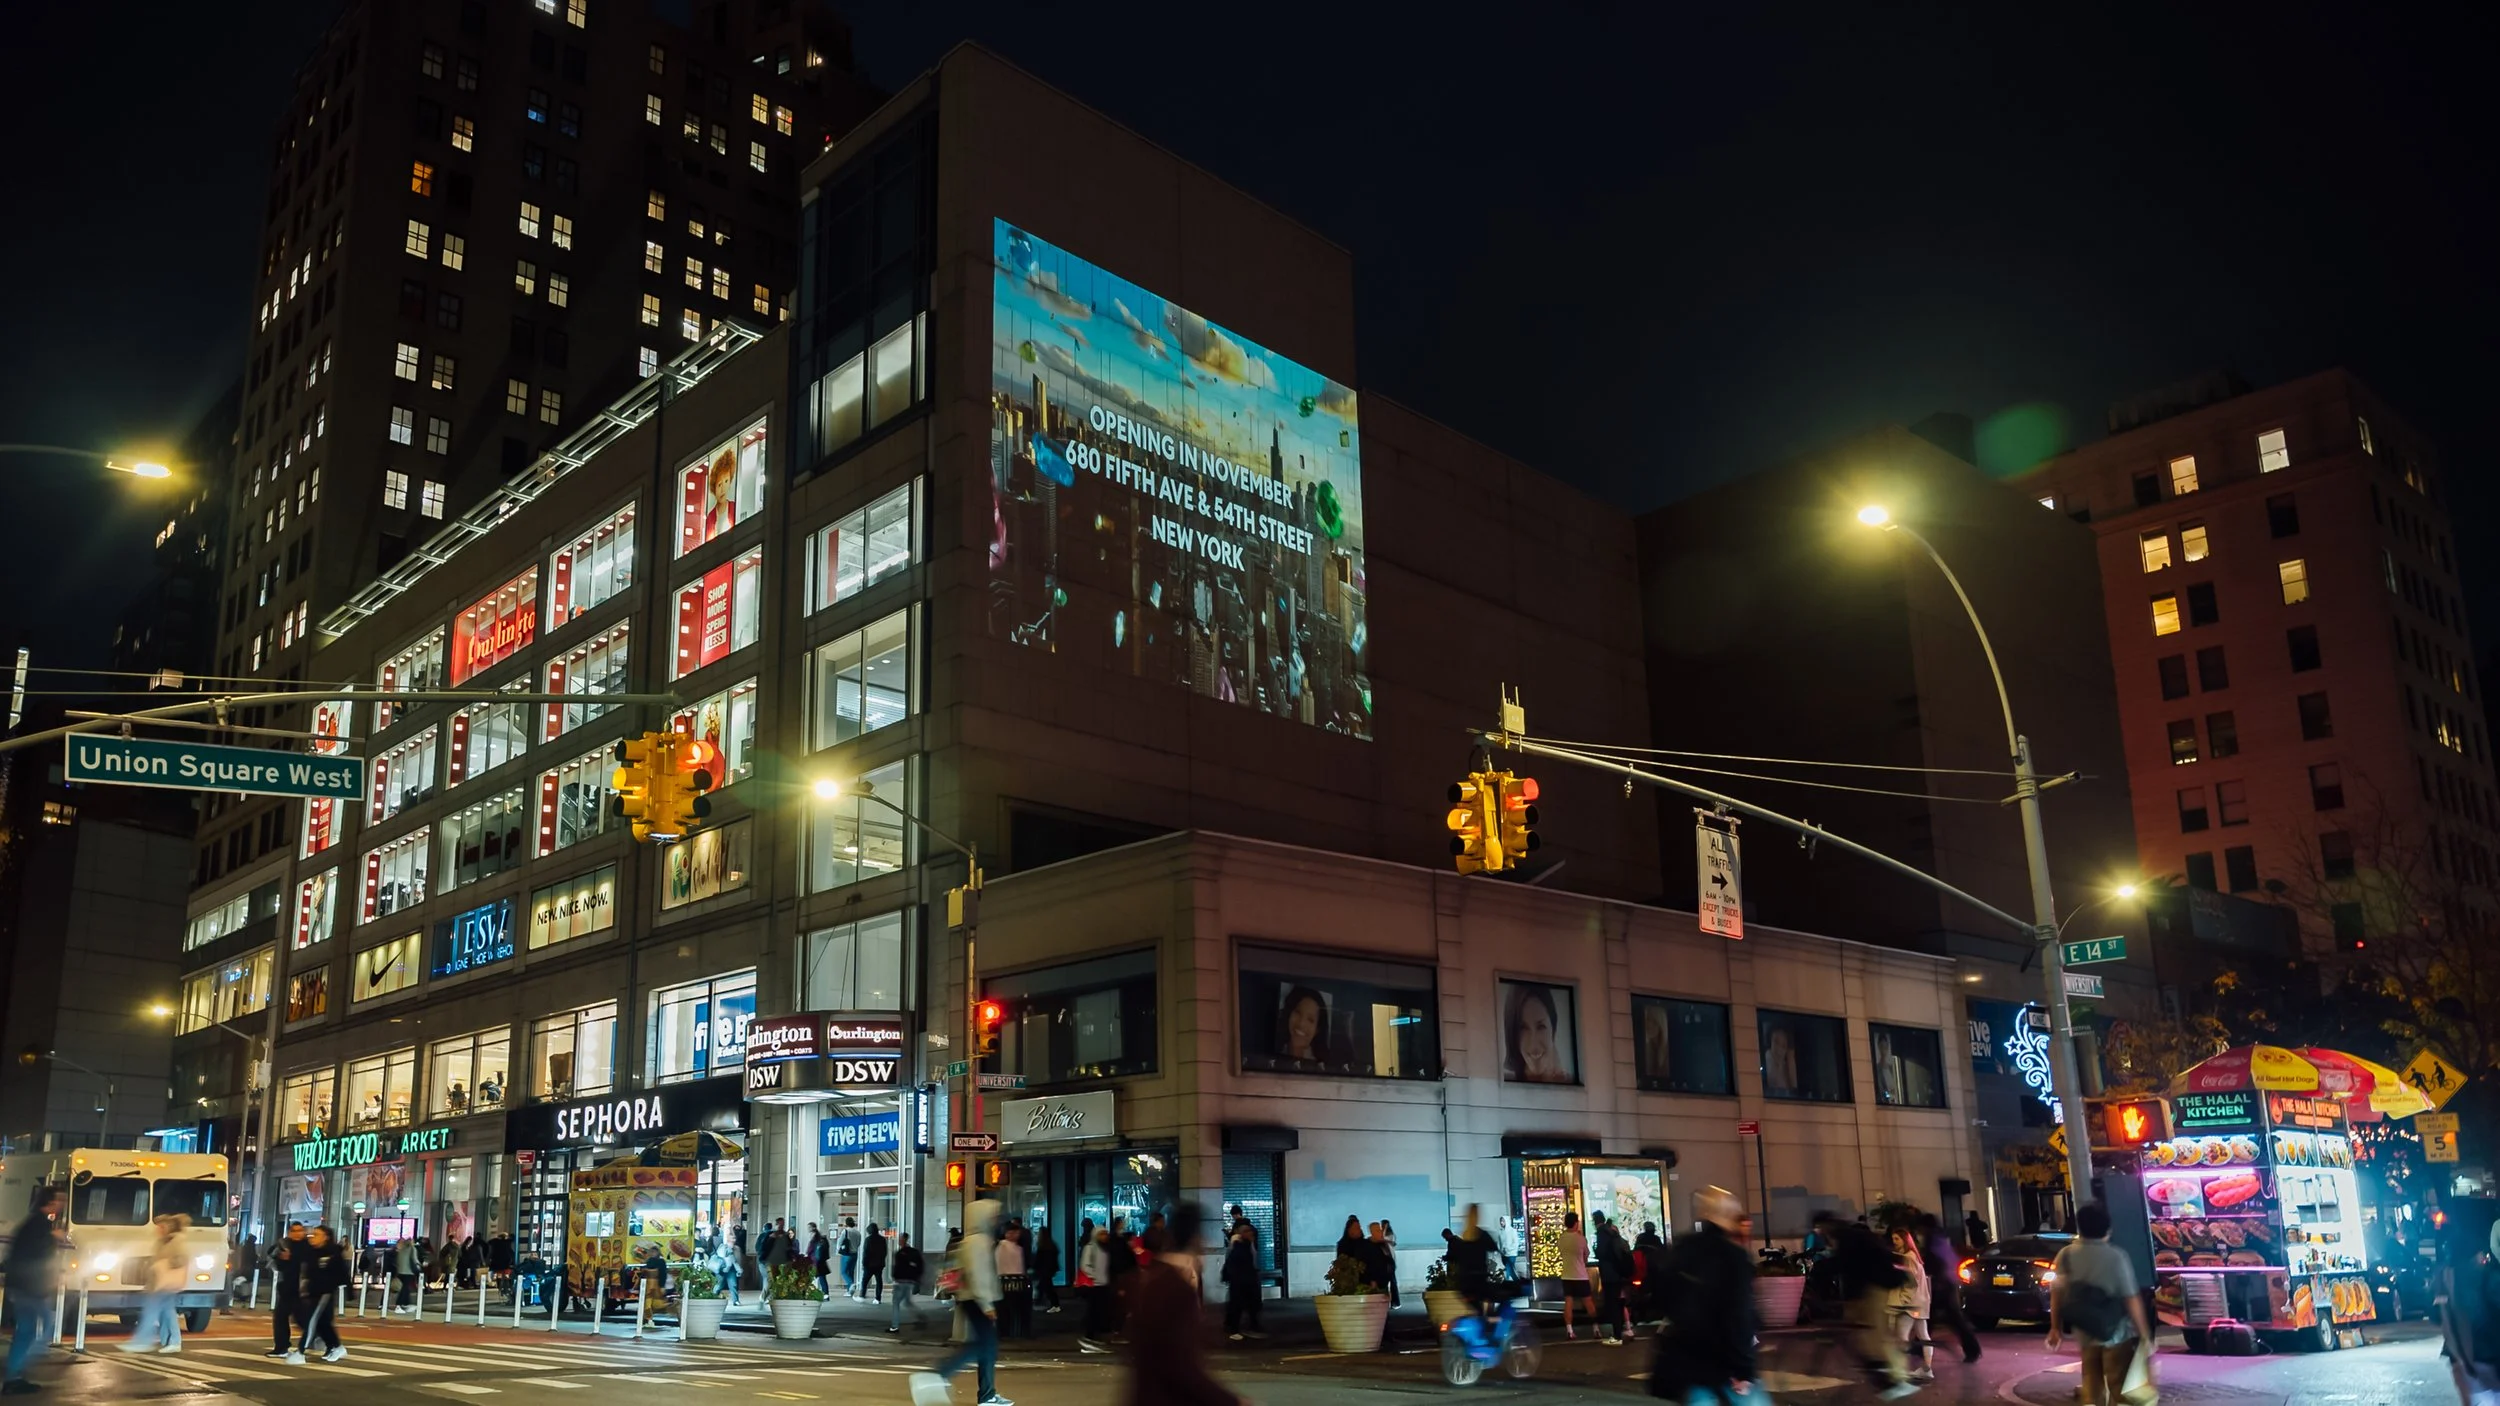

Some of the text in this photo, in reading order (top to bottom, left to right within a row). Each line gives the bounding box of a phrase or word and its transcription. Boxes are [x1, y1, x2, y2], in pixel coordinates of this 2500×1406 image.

[1089, 405, 1294, 510] OPENING IN NOVEMBER
[1065, 439, 1314, 556] 680 FIFTH AVE & 54TH STREET
[1151, 514, 1245, 572] NEW YORK
[707, 582, 728, 604] SHOP
[707, 598, 727, 619] MORE
[706, 615, 727, 634] SPEND
[708, 632, 723, 648] LESS
[80, 746, 352, 789] Union Square West
[1710, 837, 1727, 853] ALL
[1707, 855, 1732, 872] TRAFFIC
[537, 891, 608, 926] NEW. NIKE. NOW.
[2070, 940, 2117, 962] E 14 ST
[2065, 977, 2095, 993] NIVERSITY
[748, 1025, 813, 1051] rlington
[830, 1025, 901, 1043] Burlington
[1969, 1020, 1991, 1043] ive
[1971, 1042, 1992, 1057] ELOW
[750, 1065, 780, 1089] DSW
[835, 1061, 895, 1082] DSW
[979, 1075, 1017, 1087] UNIVERSITY
[2177, 1093, 2251, 1107] THE HALAL
[2281, 1098, 2295, 1112] THE
[2295, 1099, 2313, 1114] HALA
[557, 1096, 663, 1141] SEPHORA
[1027, 1103, 1084, 1135] Bolton's
[2187, 1105, 2244, 1118] KITCHEN
[827, 1120, 900, 1147] five BELOW
[958, 1138, 991, 1146] ONE WAY
[2434, 1137, 2446, 1151] 5
[294, 1128, 449, 1171] WHOLE FOOD ARKET
